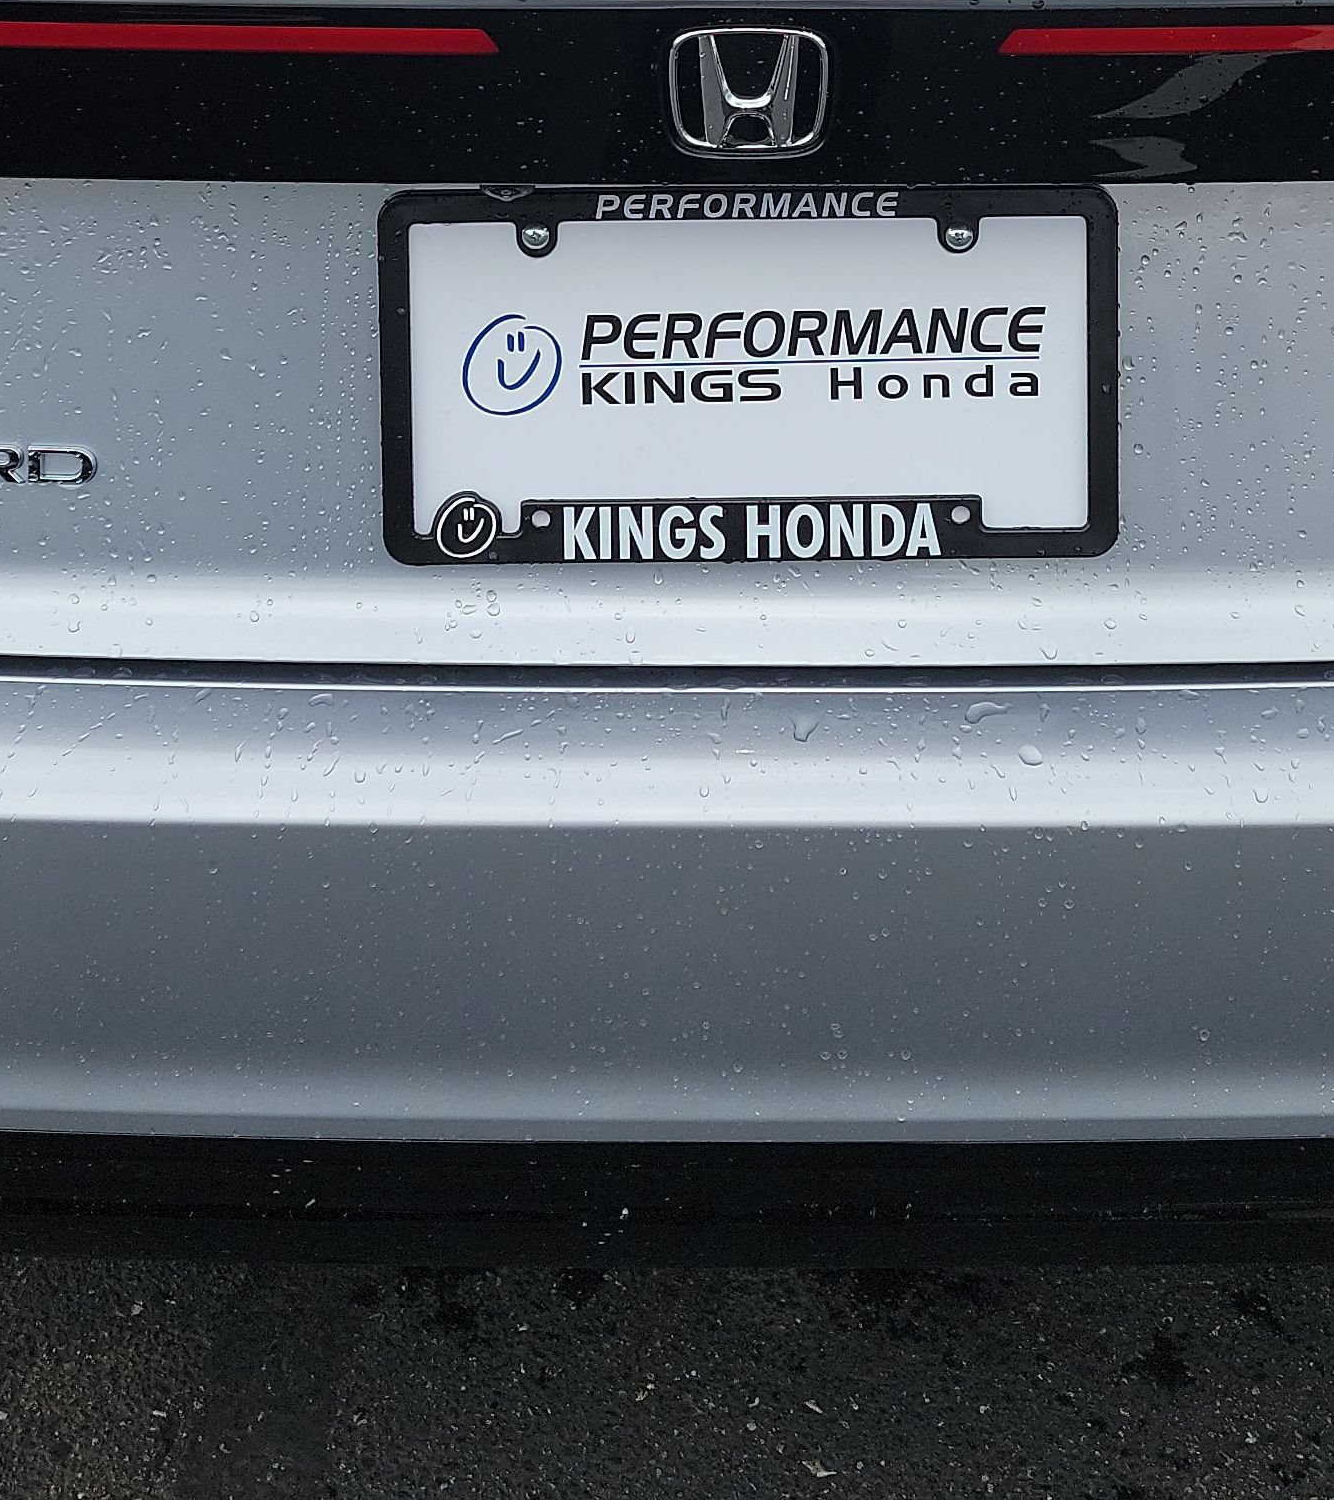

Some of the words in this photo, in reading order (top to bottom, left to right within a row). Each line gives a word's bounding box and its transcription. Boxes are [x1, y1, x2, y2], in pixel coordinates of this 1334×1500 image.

[595, 192, 899, 220] PERFORMANCE
[581, 306, 1047, 361] PERFORMANCE
[581, 368, 782, 405] KINGS
[830, 365, 1039, 400] Honda
[563, 505, 726, 560] KINGS
[746, 503, 942, 559] HONDA
